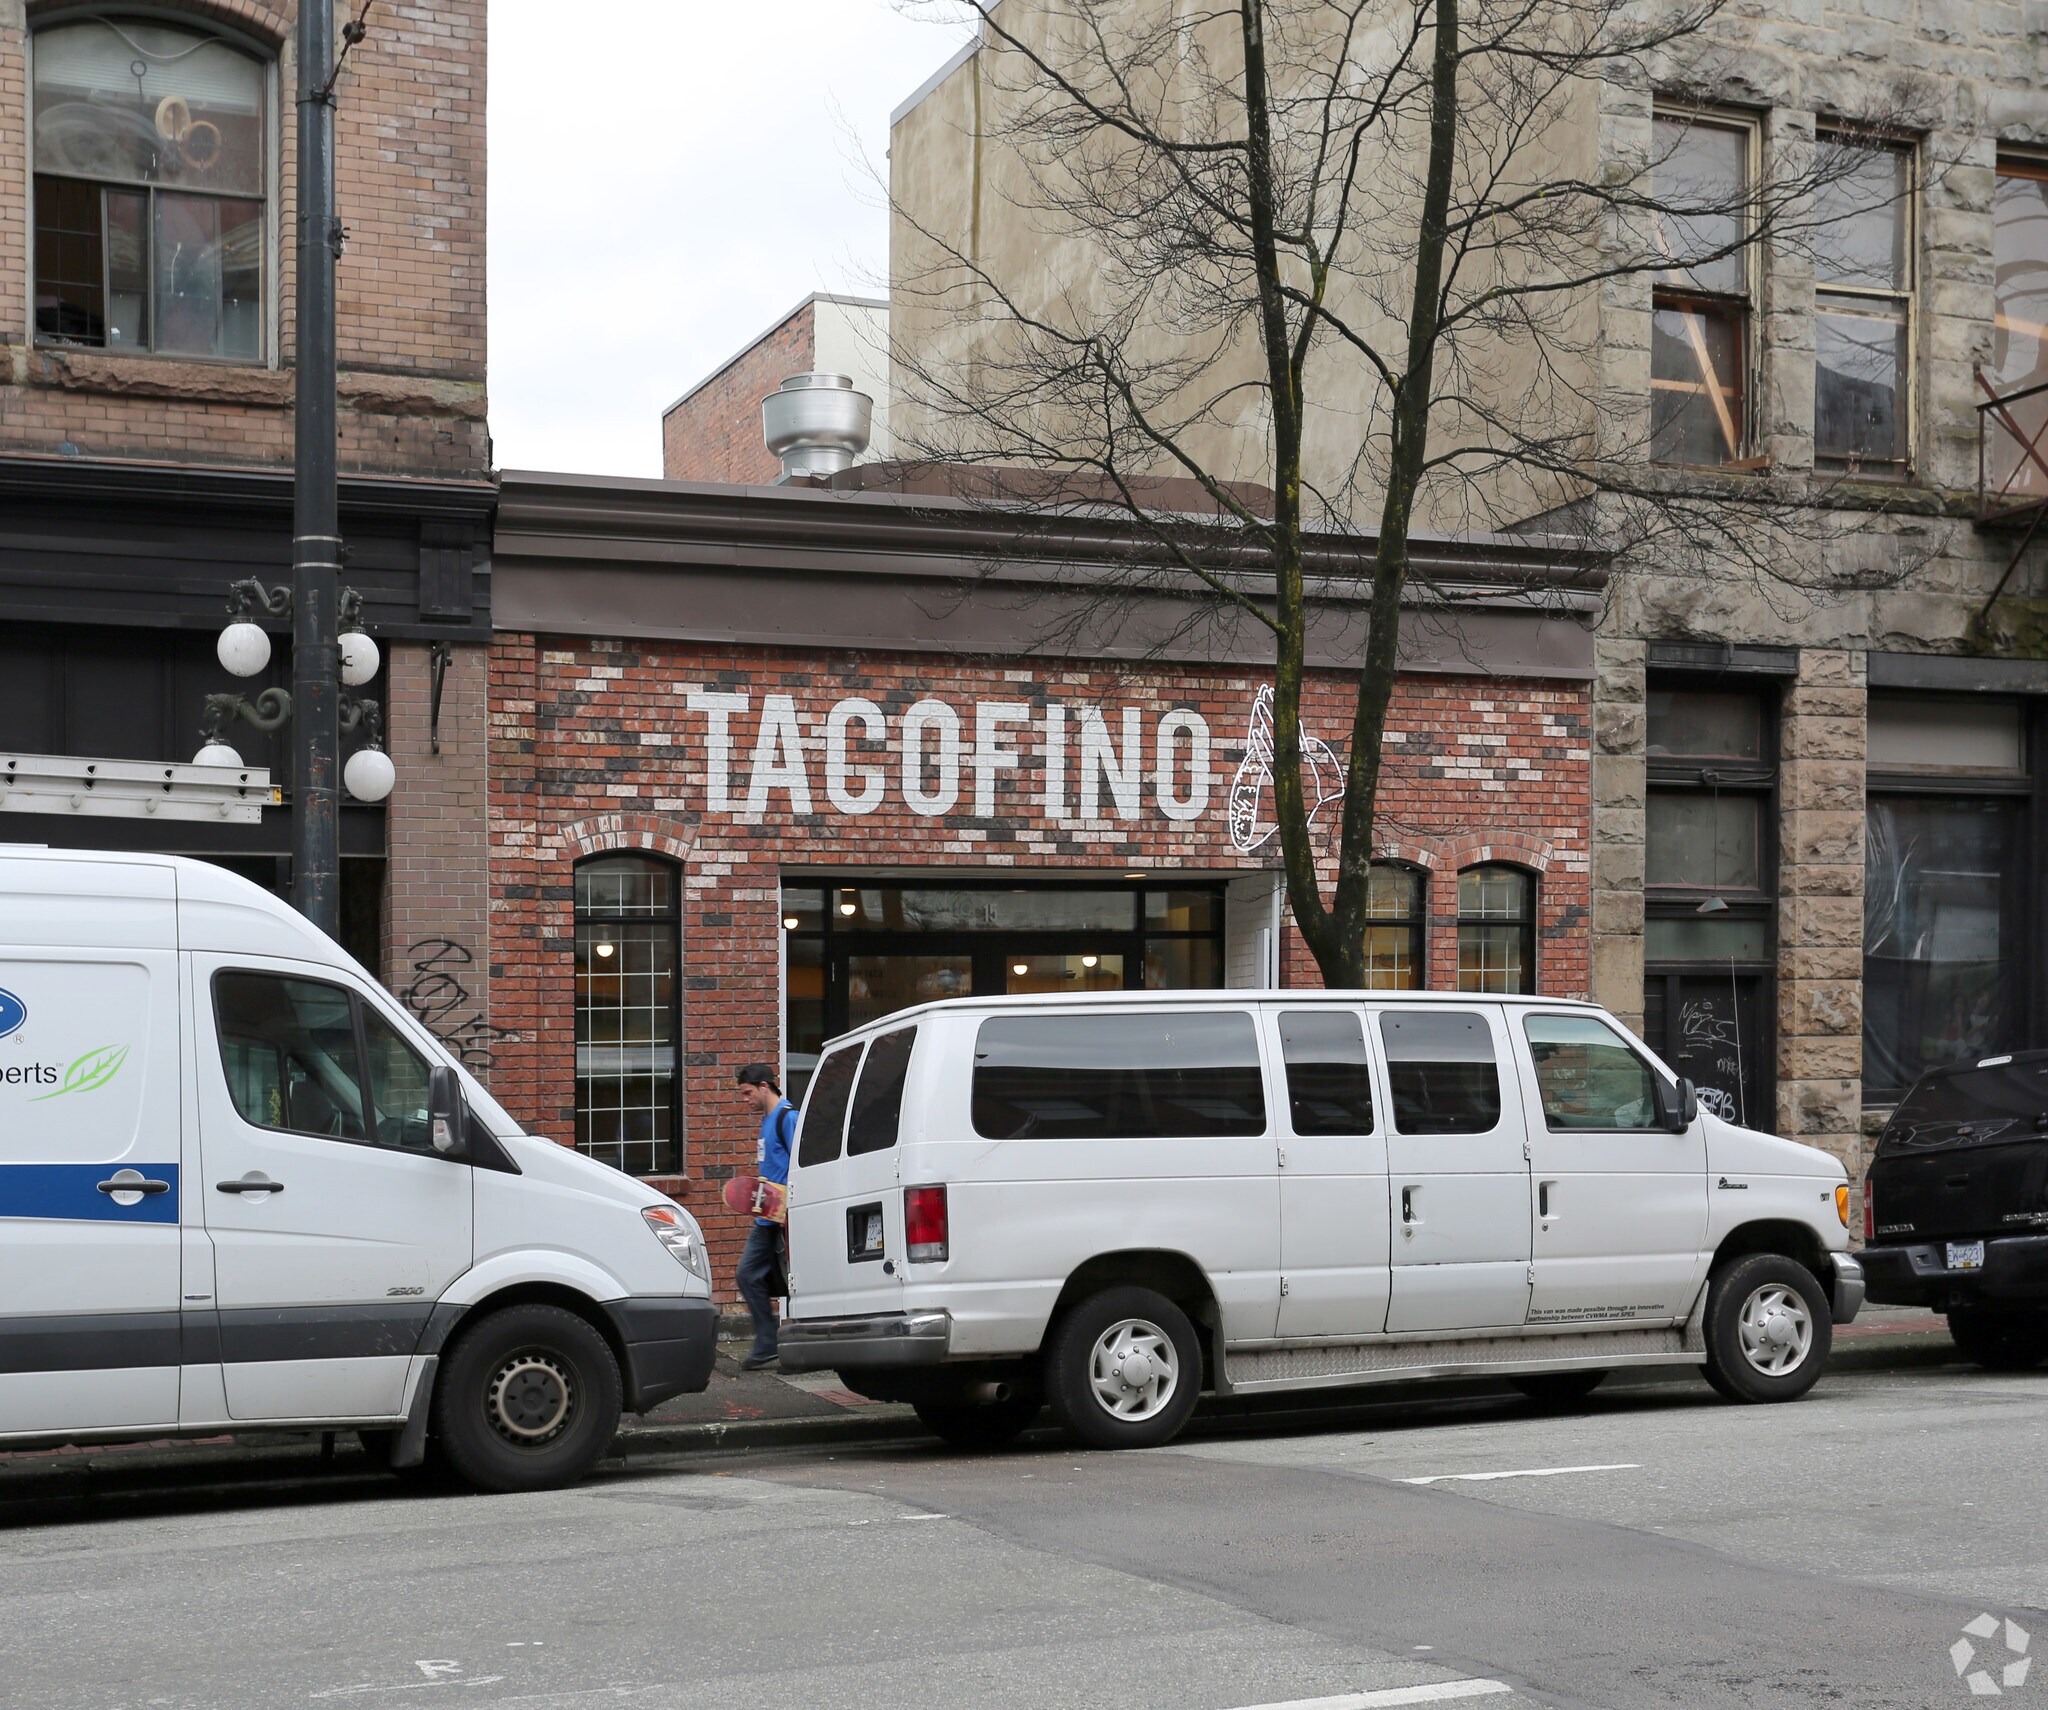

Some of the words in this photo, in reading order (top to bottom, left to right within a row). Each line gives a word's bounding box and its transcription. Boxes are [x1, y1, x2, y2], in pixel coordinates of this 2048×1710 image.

[686, 692, 1210, 820] TACOFINO
[0, 1062, 57, 1084] erts
[1877, 1223, 1915, 1234] HONDA
[386, 1286, 425, 1296] 2500
[1583, 1305, 1606, 1313] possible
[1607, 1304, 1628, 1312] through
